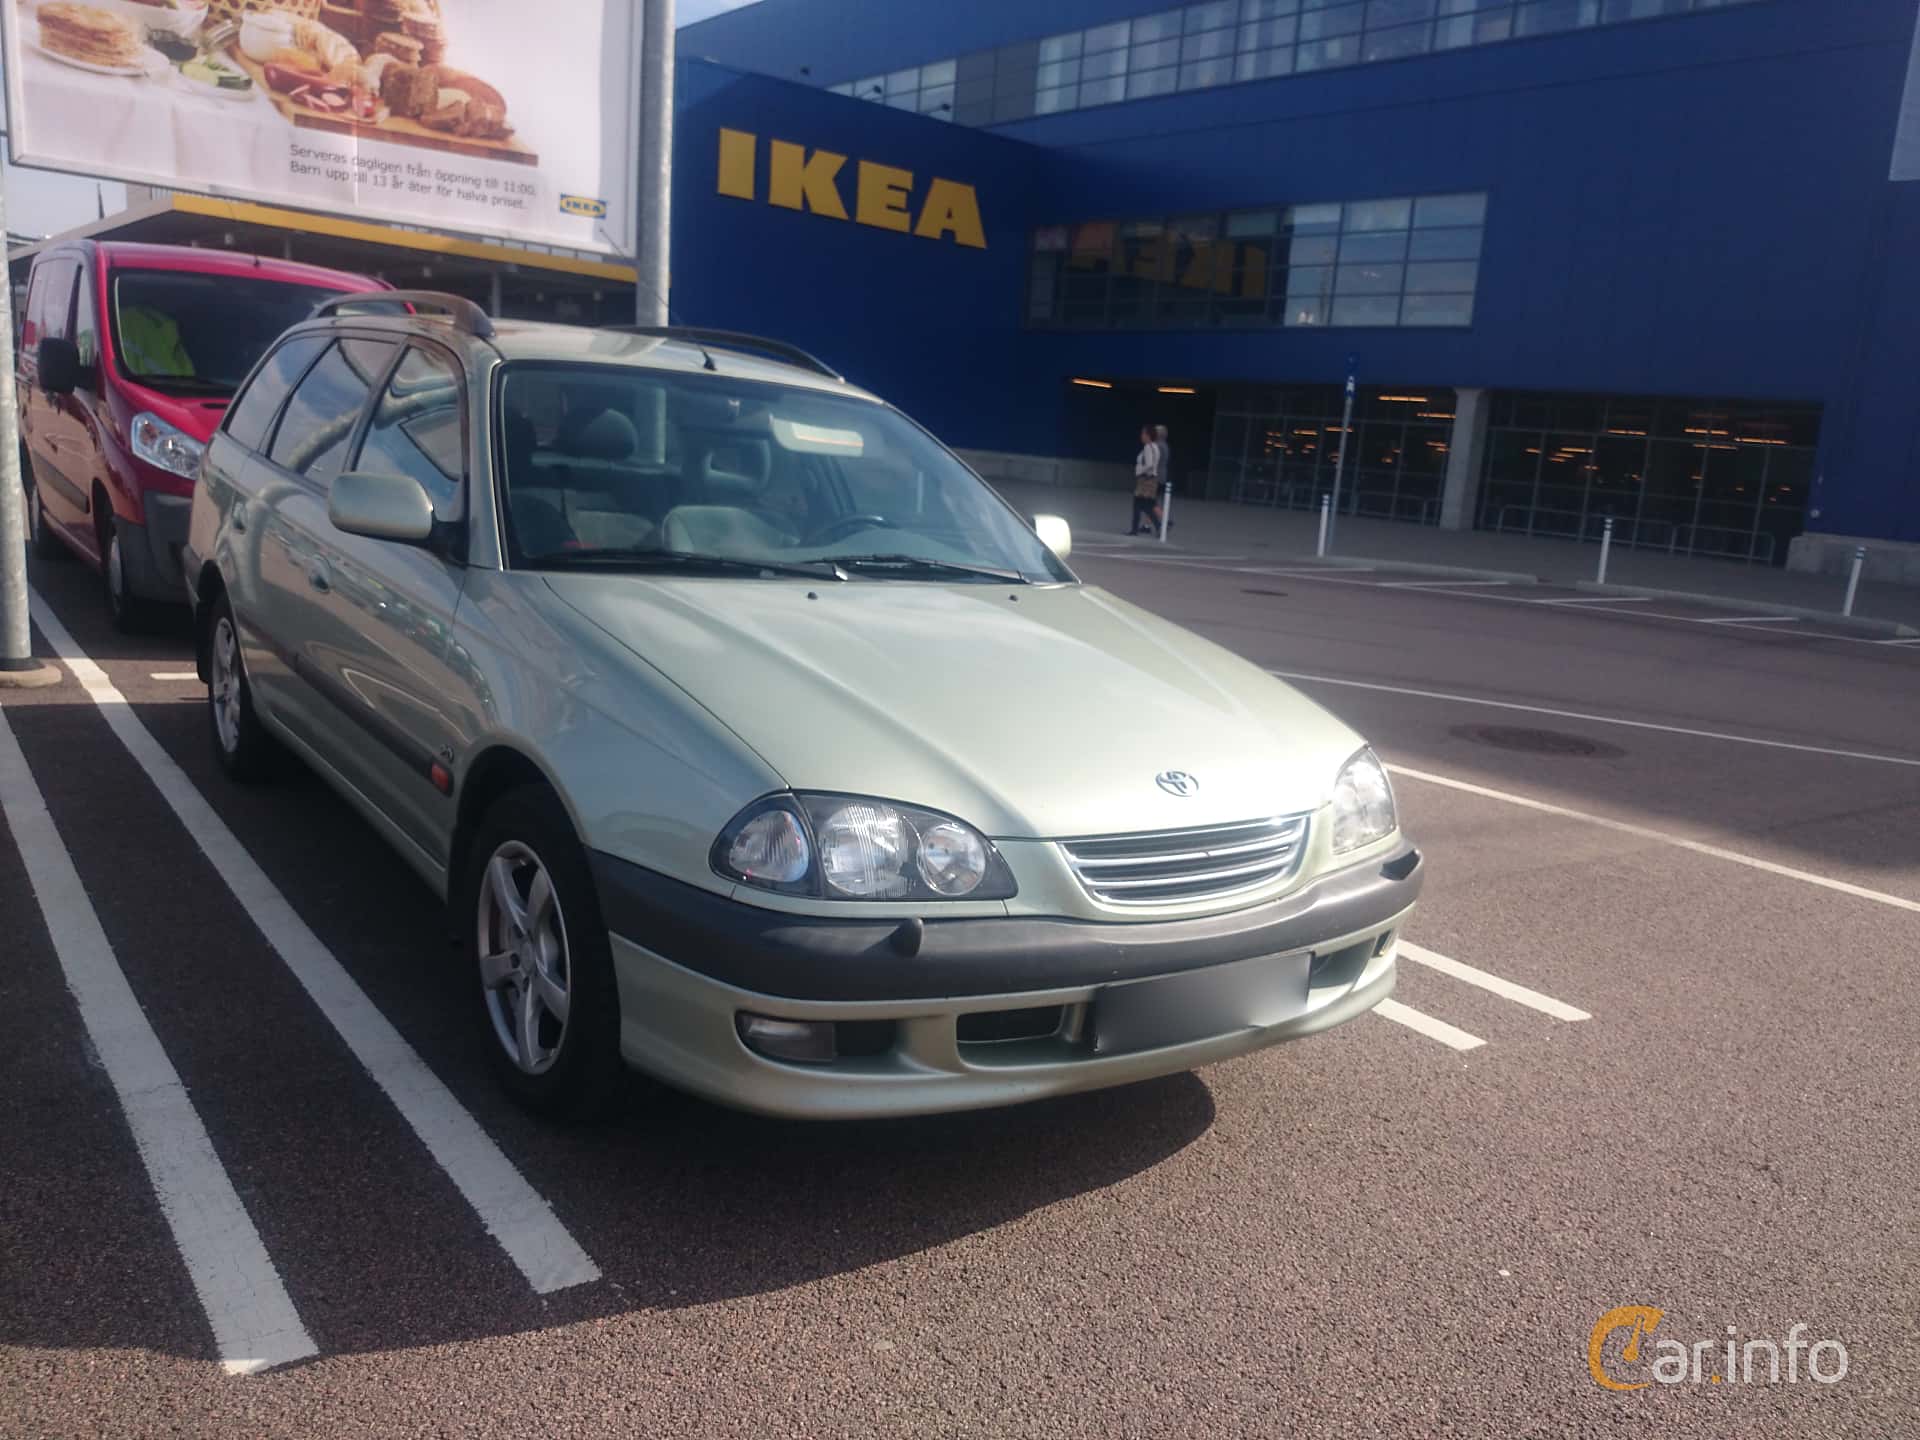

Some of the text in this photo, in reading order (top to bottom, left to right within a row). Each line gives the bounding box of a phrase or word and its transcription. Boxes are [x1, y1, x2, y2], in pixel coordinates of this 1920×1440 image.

[290, 143, 347, 164] Serveras
[352, 156, 401, 173] dagligen
[406, 162, 431, 177] från
[435, 168, 481, 189] öppning
[485, 176, 499, 189] till
[290, 159, 320, 175] Barn
[326, 167, 349, 182] upp
[374, 175, 387, 188] 13
[392, 174, 405, 189] år
[408, 180, 432, 195] äter
[437, 183, 452, 197] för
[457, 188, 488, 203] halva
[718, 127, 986, 249] IKEA
